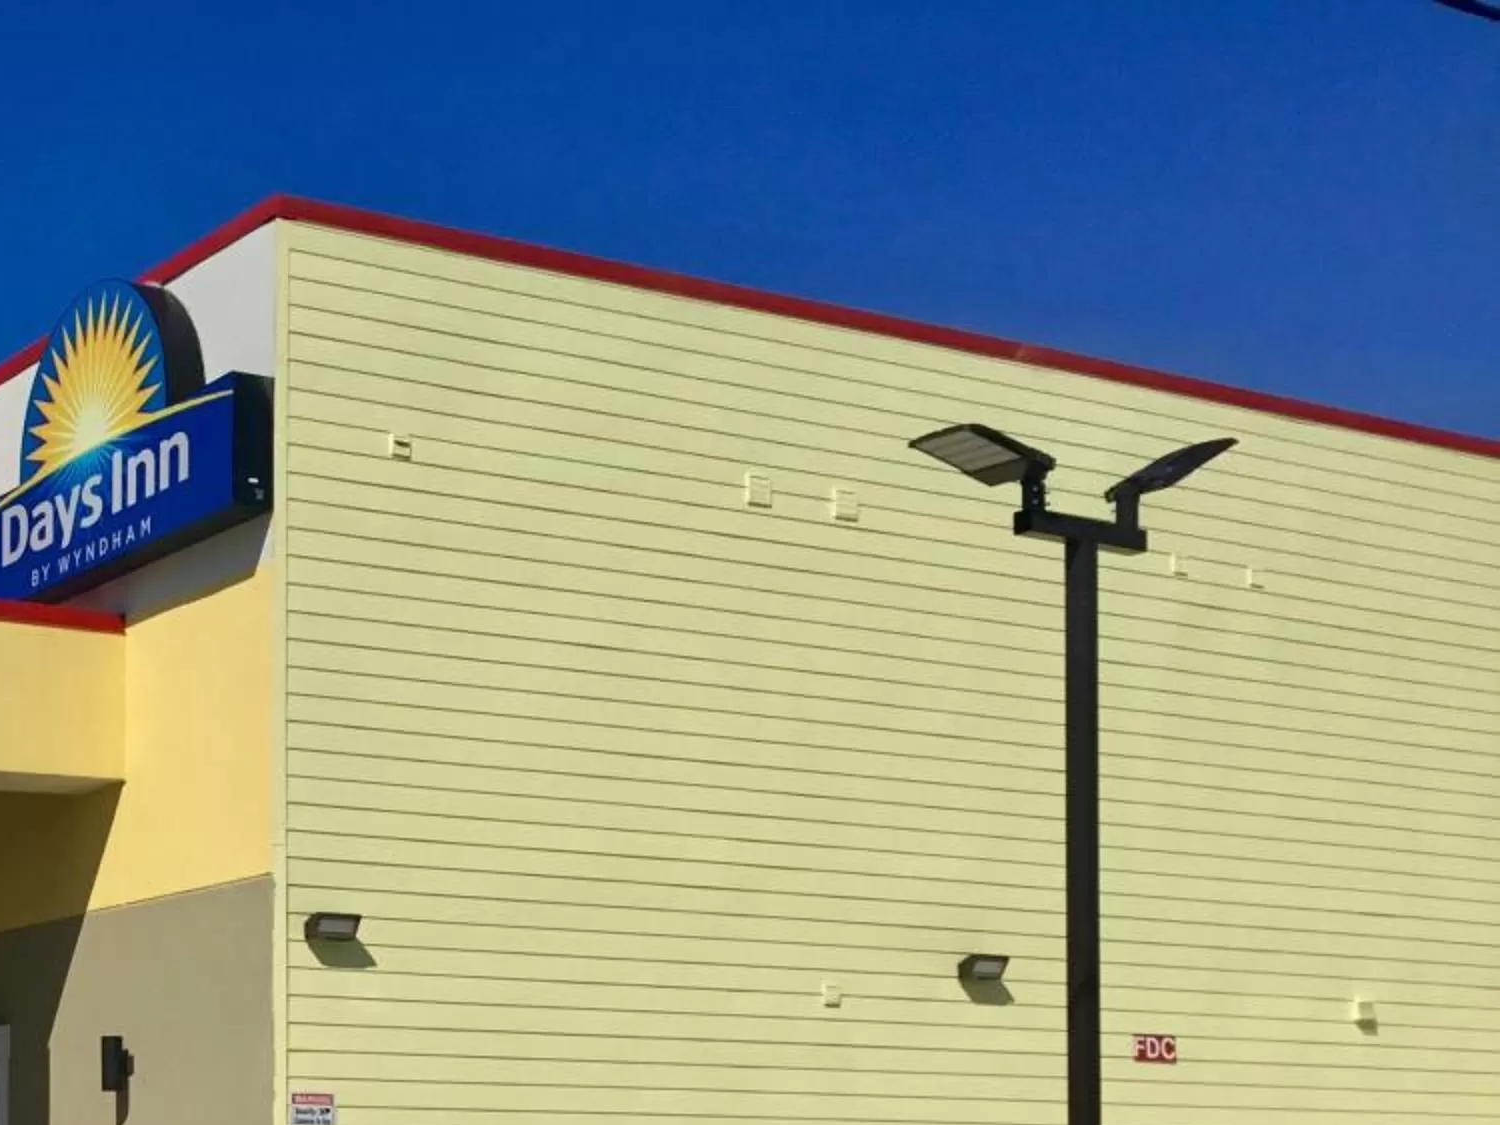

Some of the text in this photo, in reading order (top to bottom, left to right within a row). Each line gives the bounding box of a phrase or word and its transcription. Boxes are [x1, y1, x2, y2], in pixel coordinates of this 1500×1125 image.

[1, 430, 190, 568] Days Inn
[31, 515, 152, 588] BY WYNDHAM
[1134, 1035, 1176, 1060] FDC
